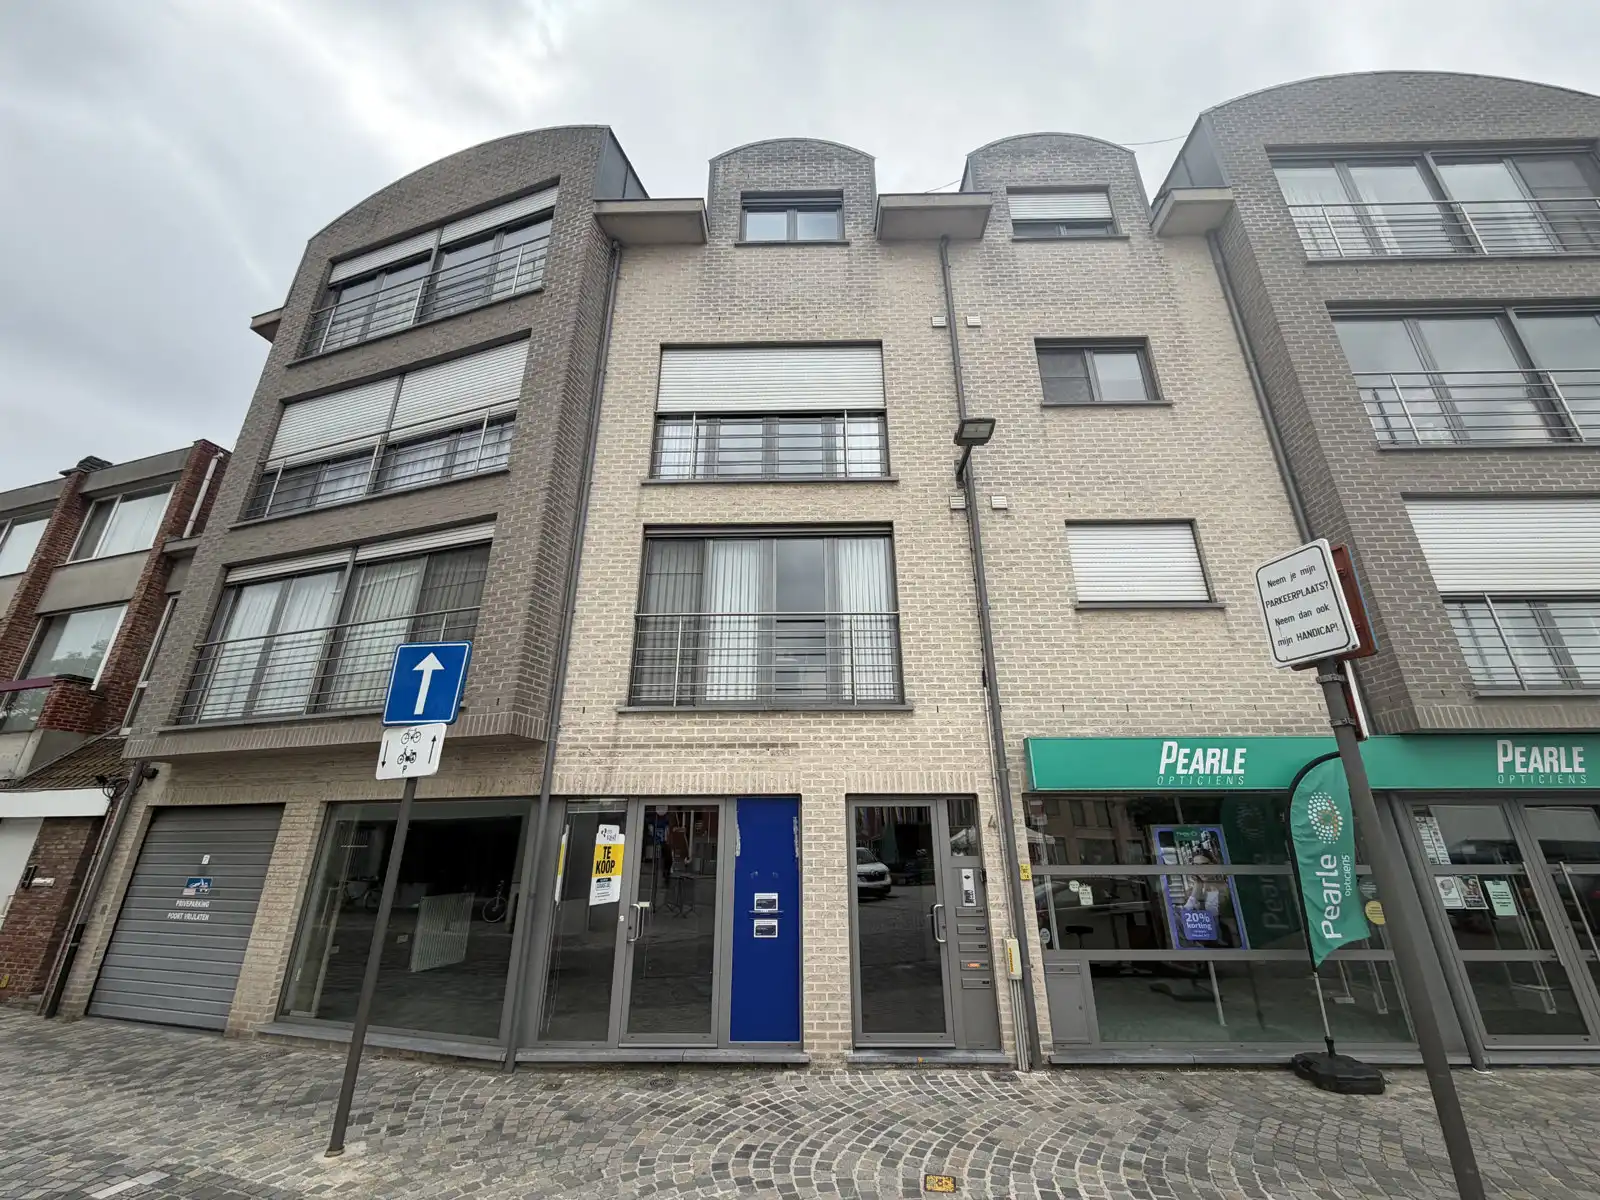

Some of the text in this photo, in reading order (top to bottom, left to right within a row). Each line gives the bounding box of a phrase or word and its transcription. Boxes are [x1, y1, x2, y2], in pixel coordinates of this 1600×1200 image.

[1267, 564, 1316, 588] Neem je mijn
[1265, 580, 1329, 608] PARKEERPLAATS?
[1274, 602, 1330, 626] Neem dan ook
[1277, 622, 1340, 647] mijn HANDICAP!
[1159, 741, 1247, 774] PEARLE
[1497, 739, 1586, 773] PEARLE
[402, 764, 408, 775] P
[1157, 775, 1245, 785] OPTICIENS
[1497, 774, 1587, 784] OPTICIENS
[602, 846, 612, 860] TE
[595, 860, 616, 874] KOOP
[1341, 854, 1353, 897] opticiens
[1315, 854, 1343, 939] Pearle
[167, 912, 184, 920] POORT
[1184, 912, 1210, 923] 20%
